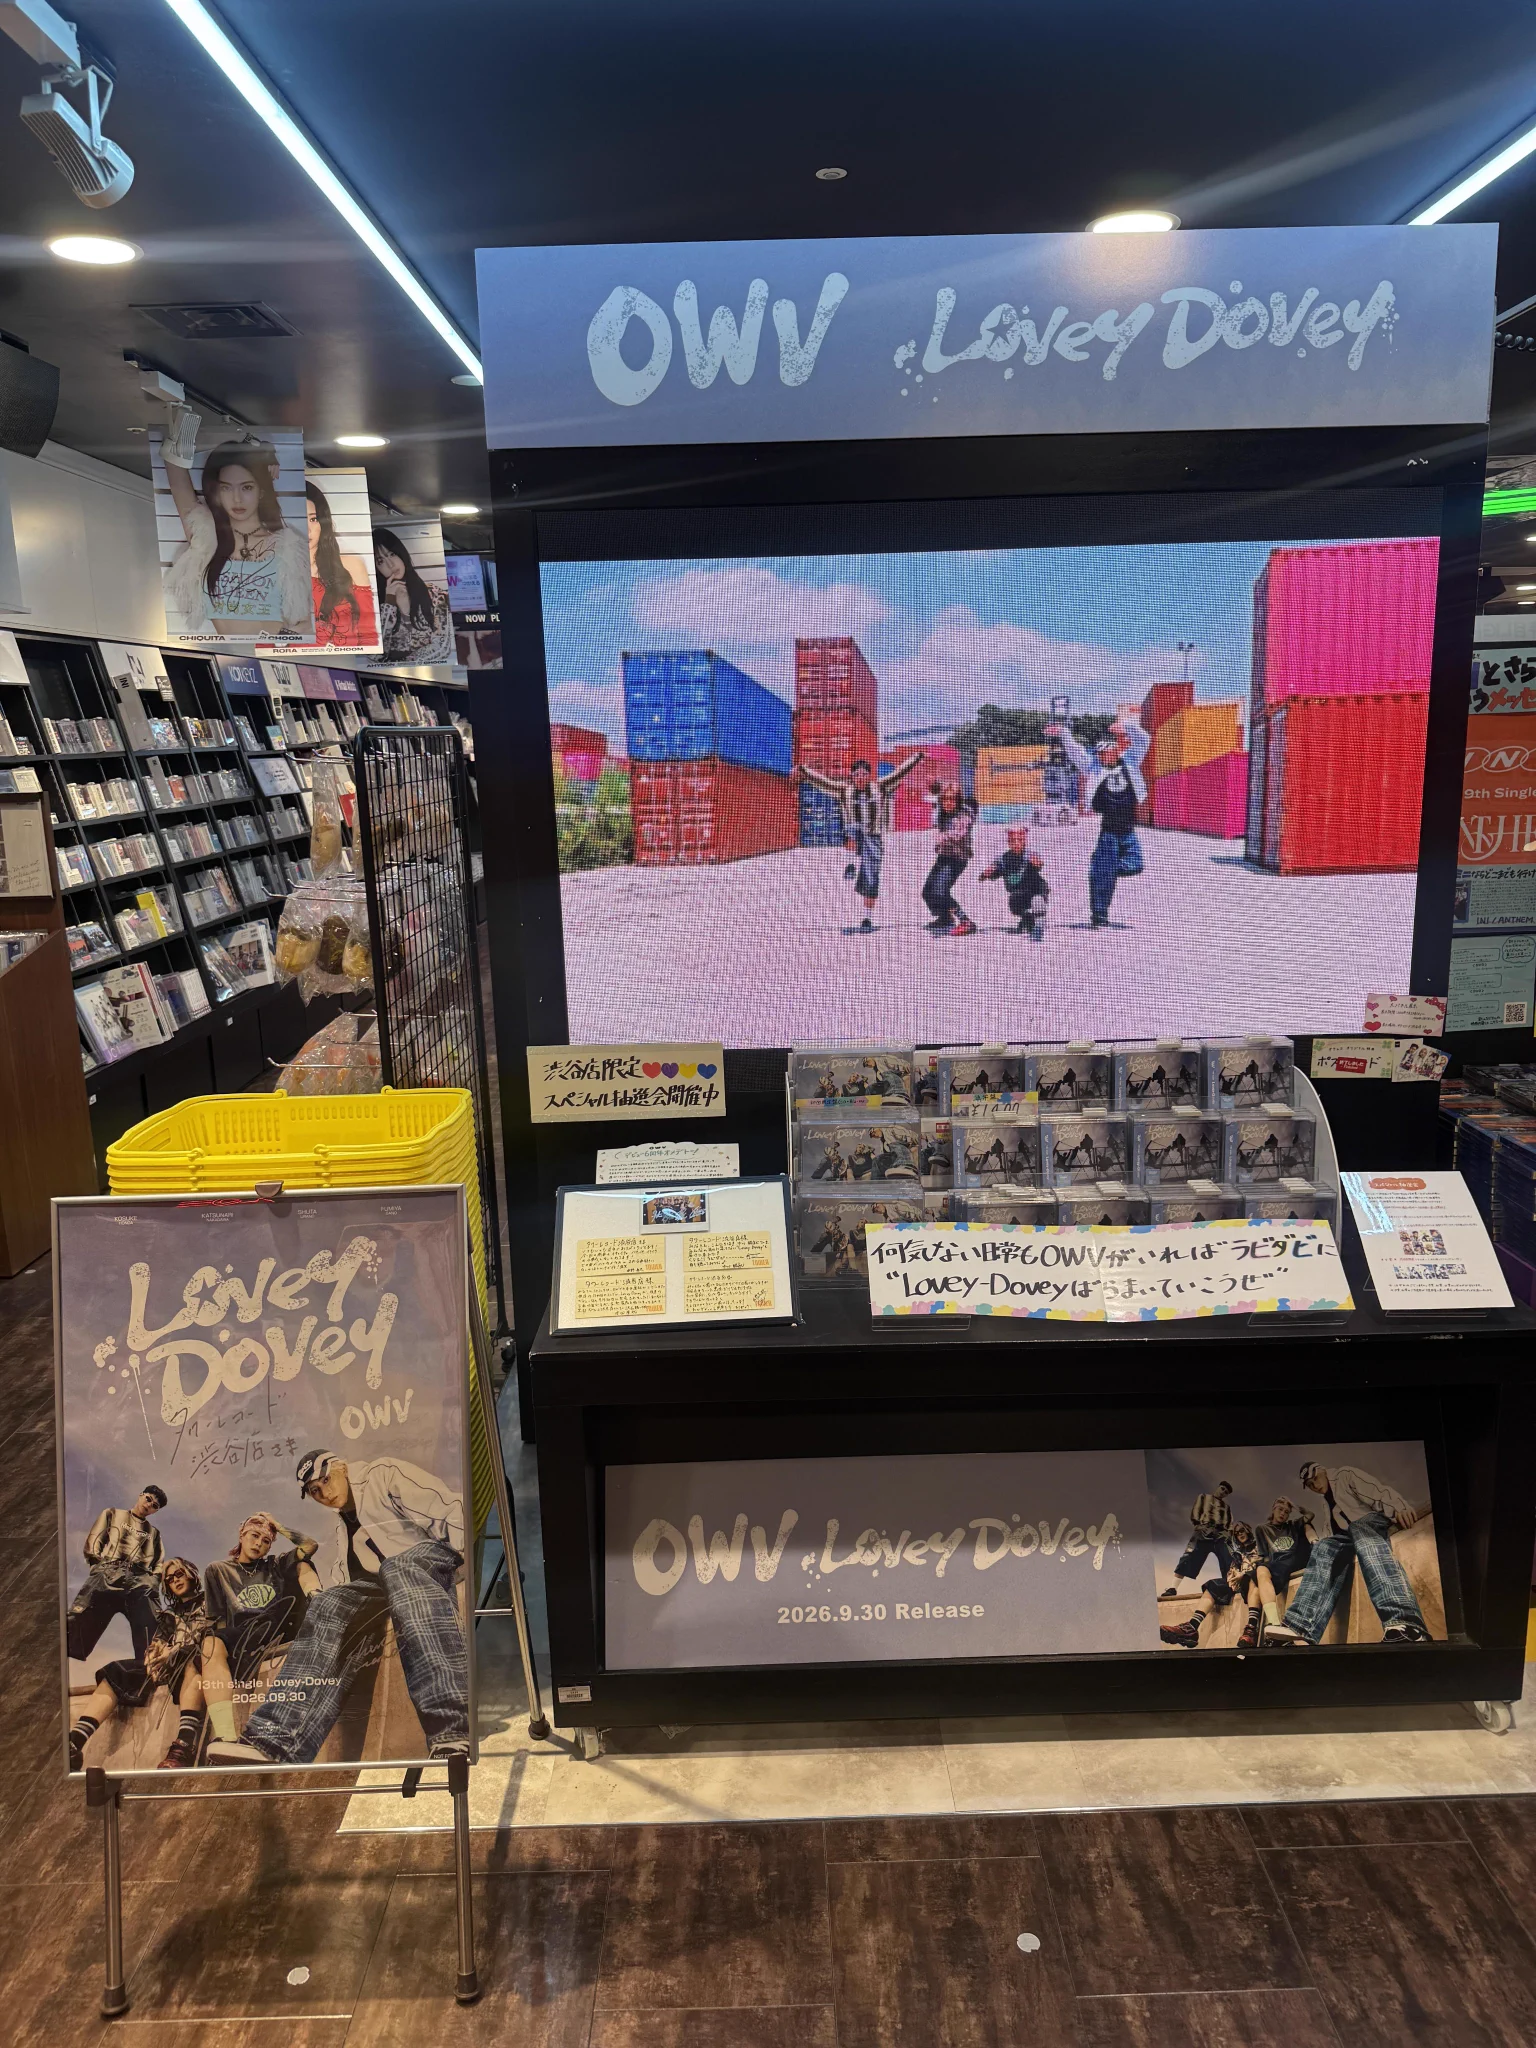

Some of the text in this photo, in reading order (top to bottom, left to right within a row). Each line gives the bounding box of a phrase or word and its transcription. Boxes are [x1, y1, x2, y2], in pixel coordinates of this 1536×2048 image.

[587, 273, 849, 405] OWV
[465, 614, 486, 622] NOW
[1464, 788, 1490, 799] 9th
[543, 1056, 644, 1081] 渋谷店限定
[543, 1083, 720, 1110] スペシャル抽選会開催中
[340, 1389, 414, 1438] OWV
[631, 1508, 799, 1596] OWV
[777, 1600, 985, 1624] 2026.9.30 Release
[197, 1677, 342, 1691] 13th single Lovey-Dovey
[232, 1692, 306, 1704] 2026.09.30
